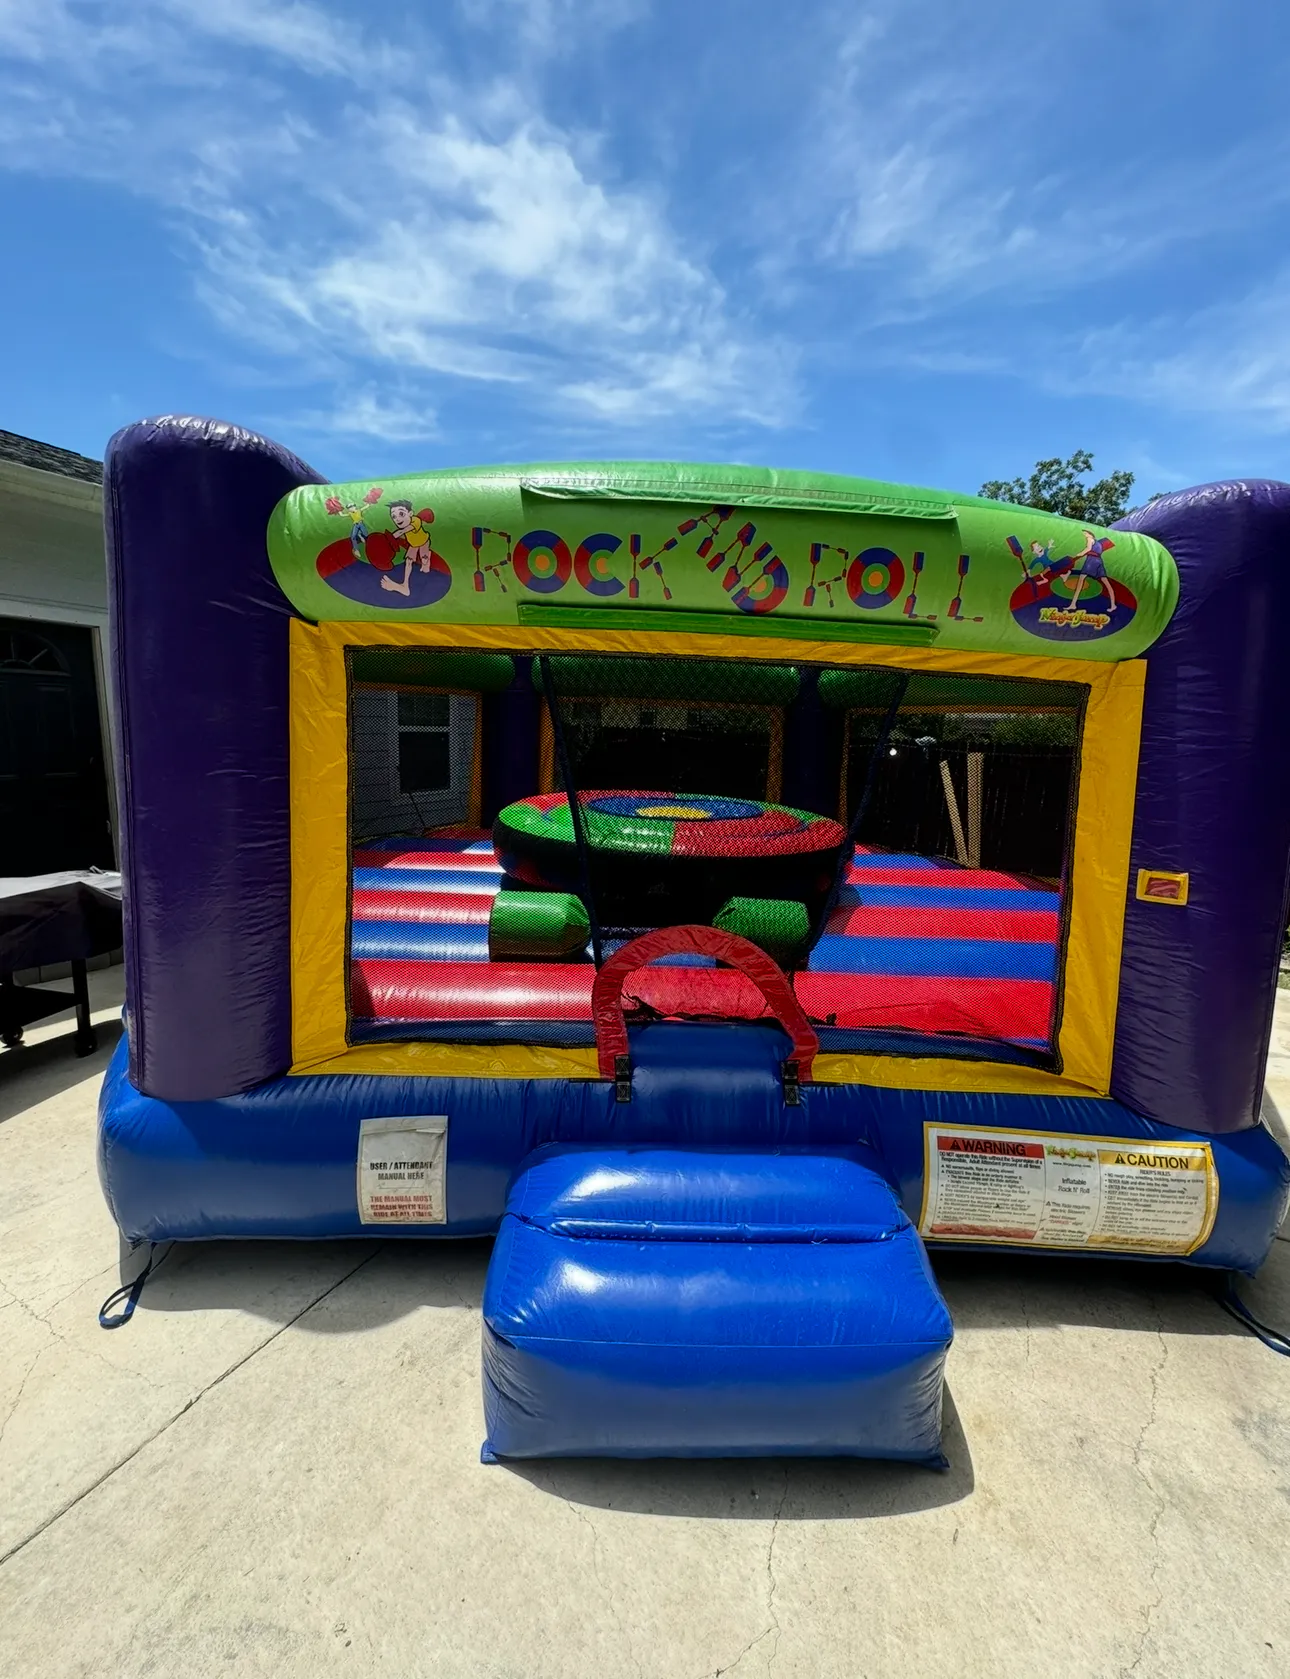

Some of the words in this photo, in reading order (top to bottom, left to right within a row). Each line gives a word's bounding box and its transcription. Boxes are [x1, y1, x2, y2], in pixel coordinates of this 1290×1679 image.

[471, 526, 677, 600] ROCK
[677, 504, 789, 614] AND
[802, 541, 984, 622] ROLL
[962, 1139, 1026, 1156] WARNING
[1127, 1153, 1189, 1169] CAUTION
[369, 1162, 388, 1171] USER
[394, 1161, 433, 1170] ATTENDANT
[378, 1172, 406, 1180] MANUAL
[407, 1171, 425, 1180] HERE
[1062, 1177, 1087, 1186] Inflatable
[1058, 1185, 1073, 1193] Rock
[370, 1195, 383, 1203] THE
[384, 1195, 412, 1203] MANUAL
[413, 1195, 433, 1203] MUST
